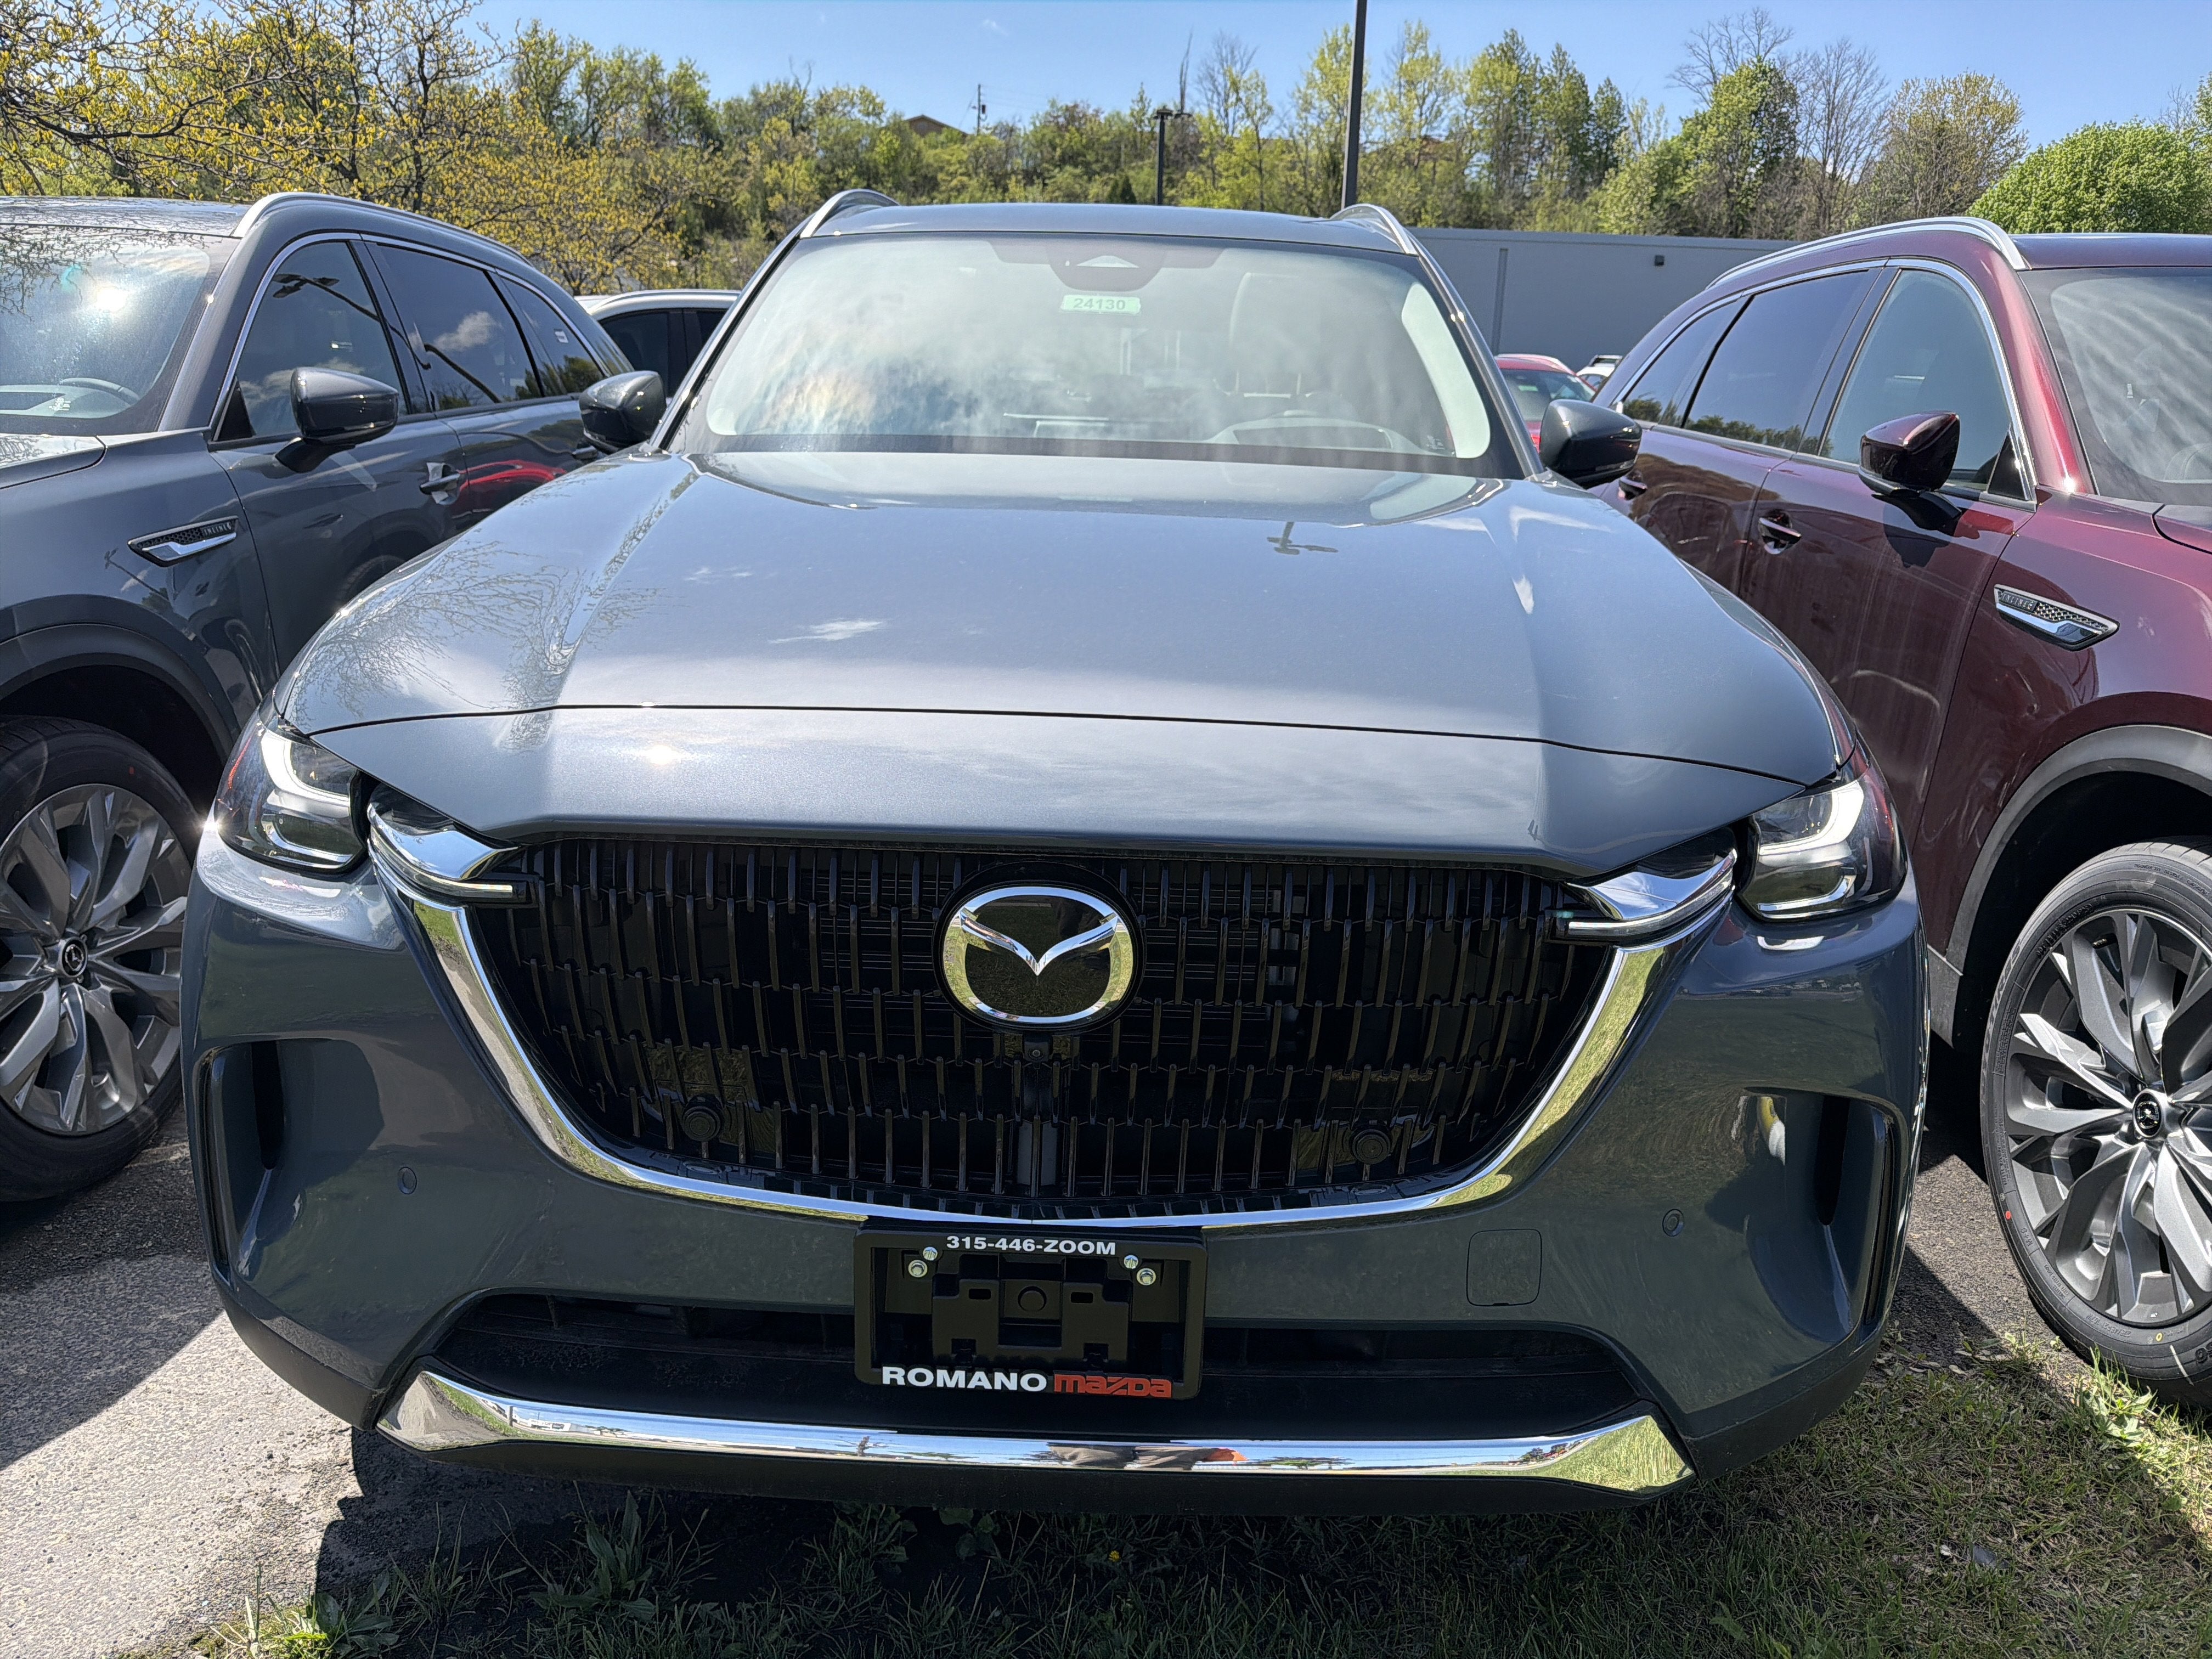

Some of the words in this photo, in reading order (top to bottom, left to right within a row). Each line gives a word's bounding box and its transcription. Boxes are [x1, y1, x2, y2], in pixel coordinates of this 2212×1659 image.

[1073, 298, 1126, 311] 24130
[946, 1235, 1116, 1255] 315-446-ZOOM
[882, 1366, 1047, 1392] ROMANO
[1054, 1374, 1172, 1398] mazda
